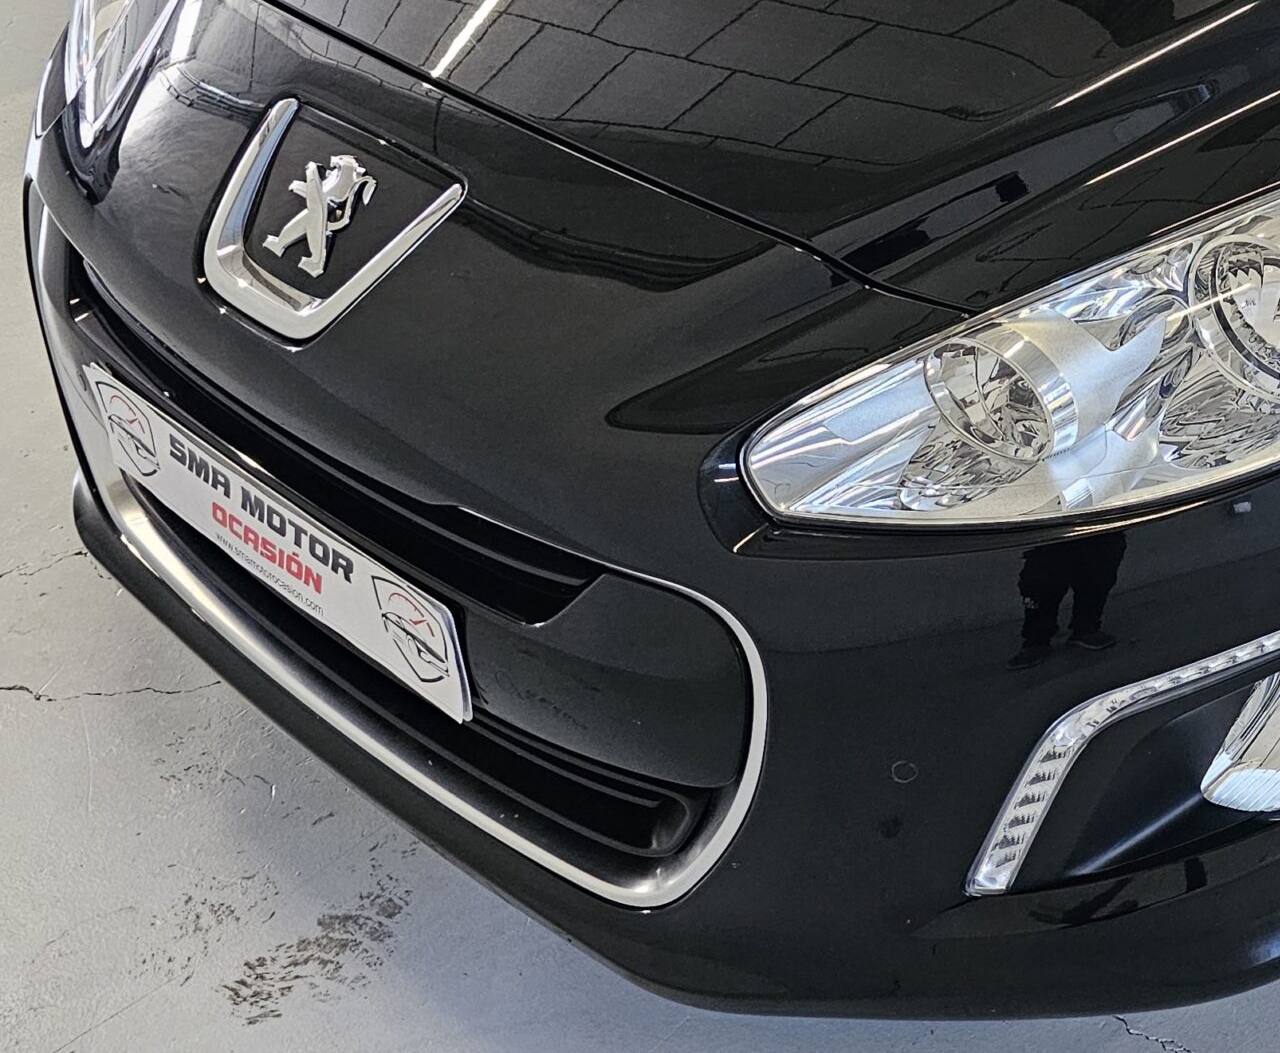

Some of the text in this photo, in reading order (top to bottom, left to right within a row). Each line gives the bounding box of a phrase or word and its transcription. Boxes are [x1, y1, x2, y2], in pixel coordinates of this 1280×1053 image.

[169, 434, 355, 584] SMA MOTOR
[211, 502, 323, 595] OCASIÓN
